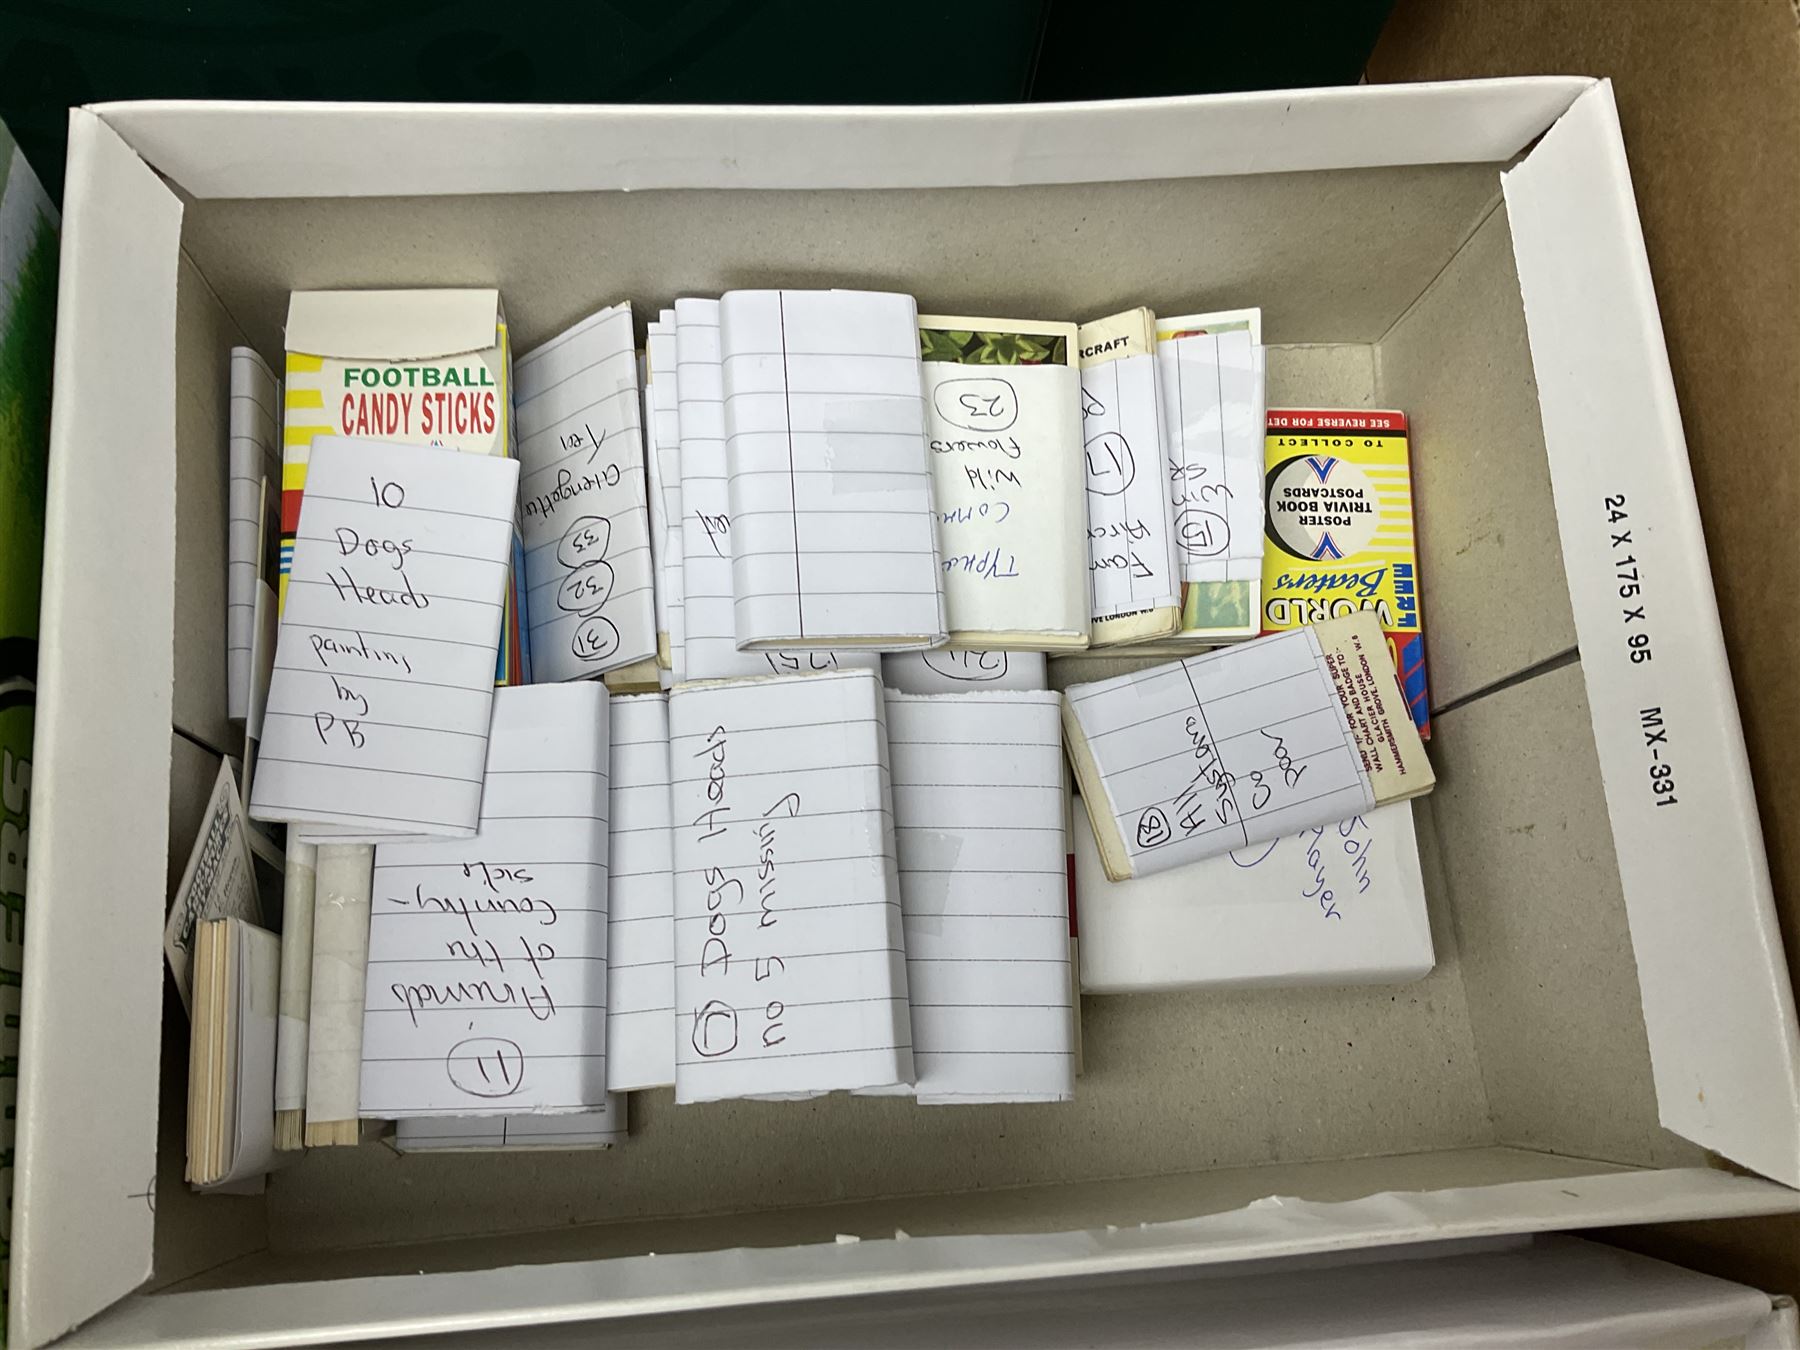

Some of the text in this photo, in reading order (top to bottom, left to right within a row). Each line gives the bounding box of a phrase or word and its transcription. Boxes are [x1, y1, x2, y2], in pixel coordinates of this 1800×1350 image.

[344, 367, 494, 387] FOOTBALL
[341, 391, 495, 435] CANDY STICKS
[959, 393, 1005, 417] 23
[1292, 418, 1313, 427] FOR
[1317, 418, 1366, 428] REVERSE
[1370, 419, 1390, 428] SEE
[1278, 438, 1383, 448] TO COLLECT
[1086, 440, 1122, 477] 17
[963, 463, 1021, 491] Wild
[370, 476, 405, 508] 10
[1283, 487, 1364, 498] POSTCARDS
[1277, 501, 1372, 513] TRIVIA BOOK
[1299, 515, 1351, 526] POSTER
[1181, 520, 1214, 547] 15
[335, 527, 413, 571] Dogs
[566, 574, 605, 597] 32
[1272, 568, 1388, 597] Beaters
[1392, 563, 1417, 628] FREE
[1265, 597, 1394, 628] WORLD
[577, 627, 608, 649] 31
[1605, 494, 1678, 807] 24 X 175 X 95 MX-331
[1341, 668, 1357, 696] BADGE
[1358, 654, 1375, 685] LONDON
[331, 675, 369, 716] by
[1336, 685, 1350, 709] YOUR
[1351, 697, 1363, 715] AND
[1355, 673, 1385, 743] GLACIER HOUSE
[1346, 714, 1357, 730] FOR
[1358, 719, 1374, 745] CHART
[1370, 746, 1383, 772] WALL
[1381, 718, 1406, 776] HAMMERSMITH
[693, 725, 731, 842] Heads
[1173, 783, 1206, 836] All
[702, 867, 744, 977] Dogs
[753, 792, 800, 1047] no 5 missing
